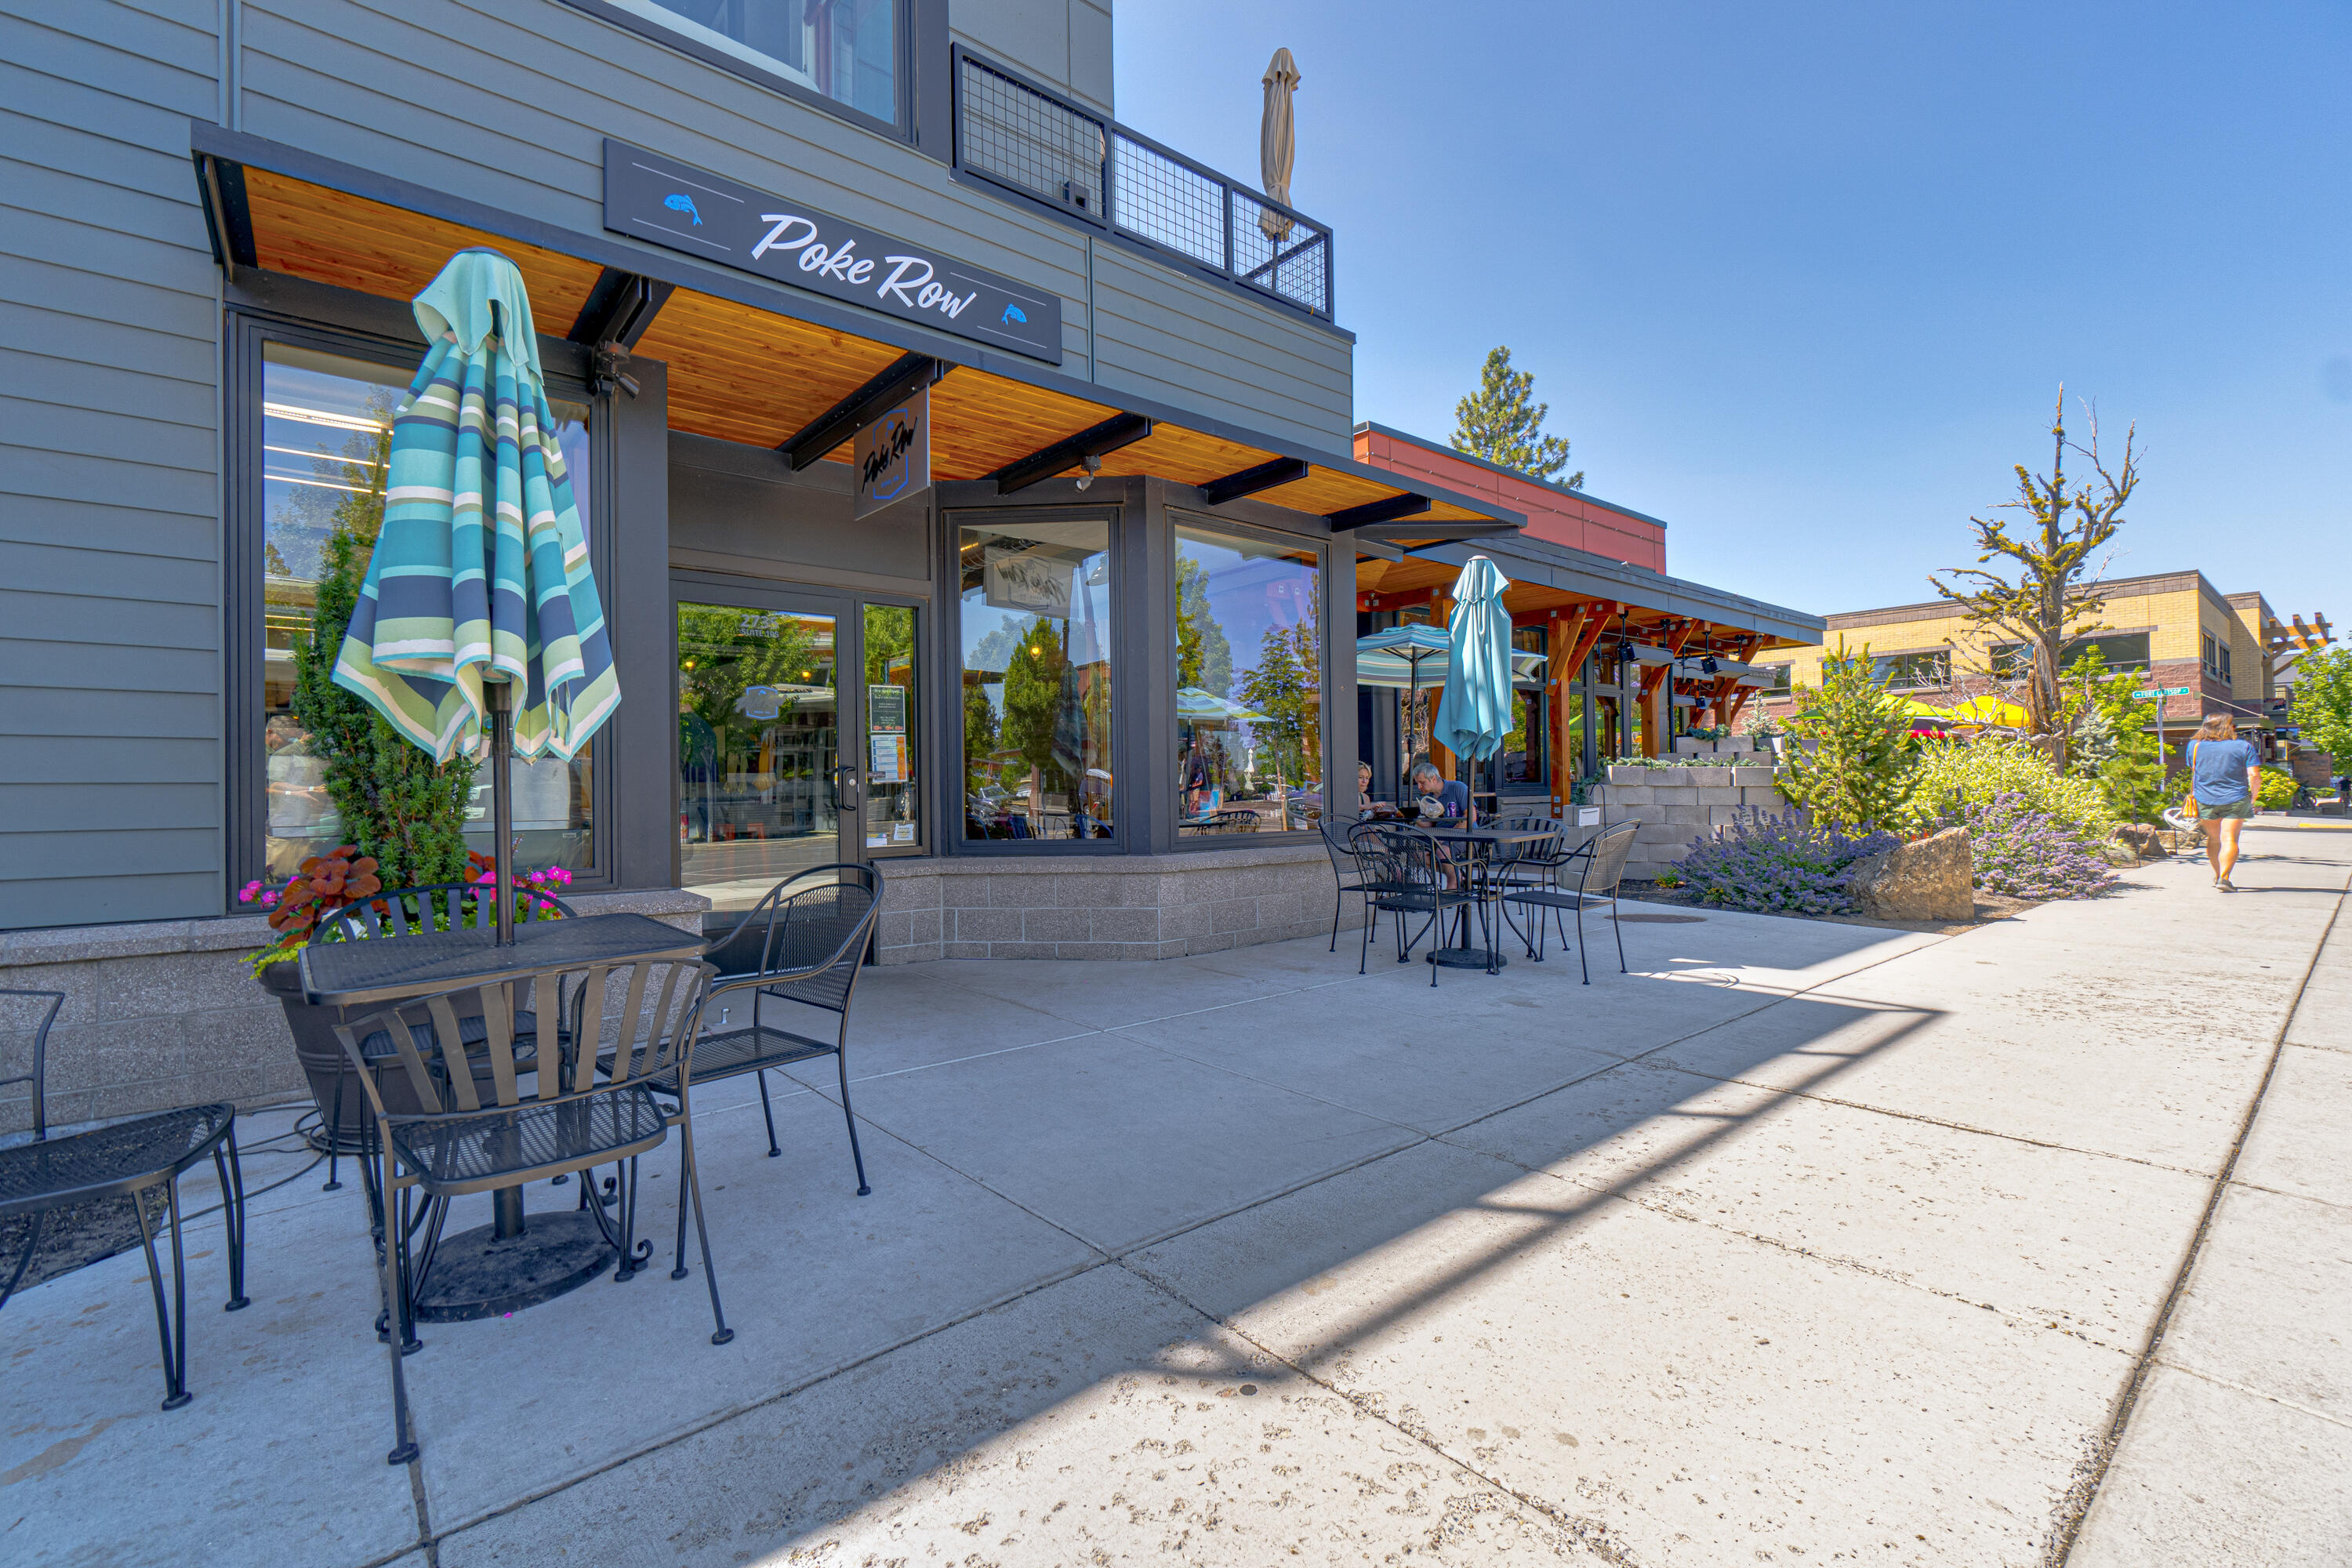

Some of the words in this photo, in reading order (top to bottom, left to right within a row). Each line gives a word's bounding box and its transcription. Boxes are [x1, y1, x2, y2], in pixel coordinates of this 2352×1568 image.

[751, 214, 875, 285] Poke
[877, 256, 977, 318] Row
[740, 614, 779, 630] 2735
[741, 628, 764, 637] SUITE
[765, 630, 779, 639] 105
